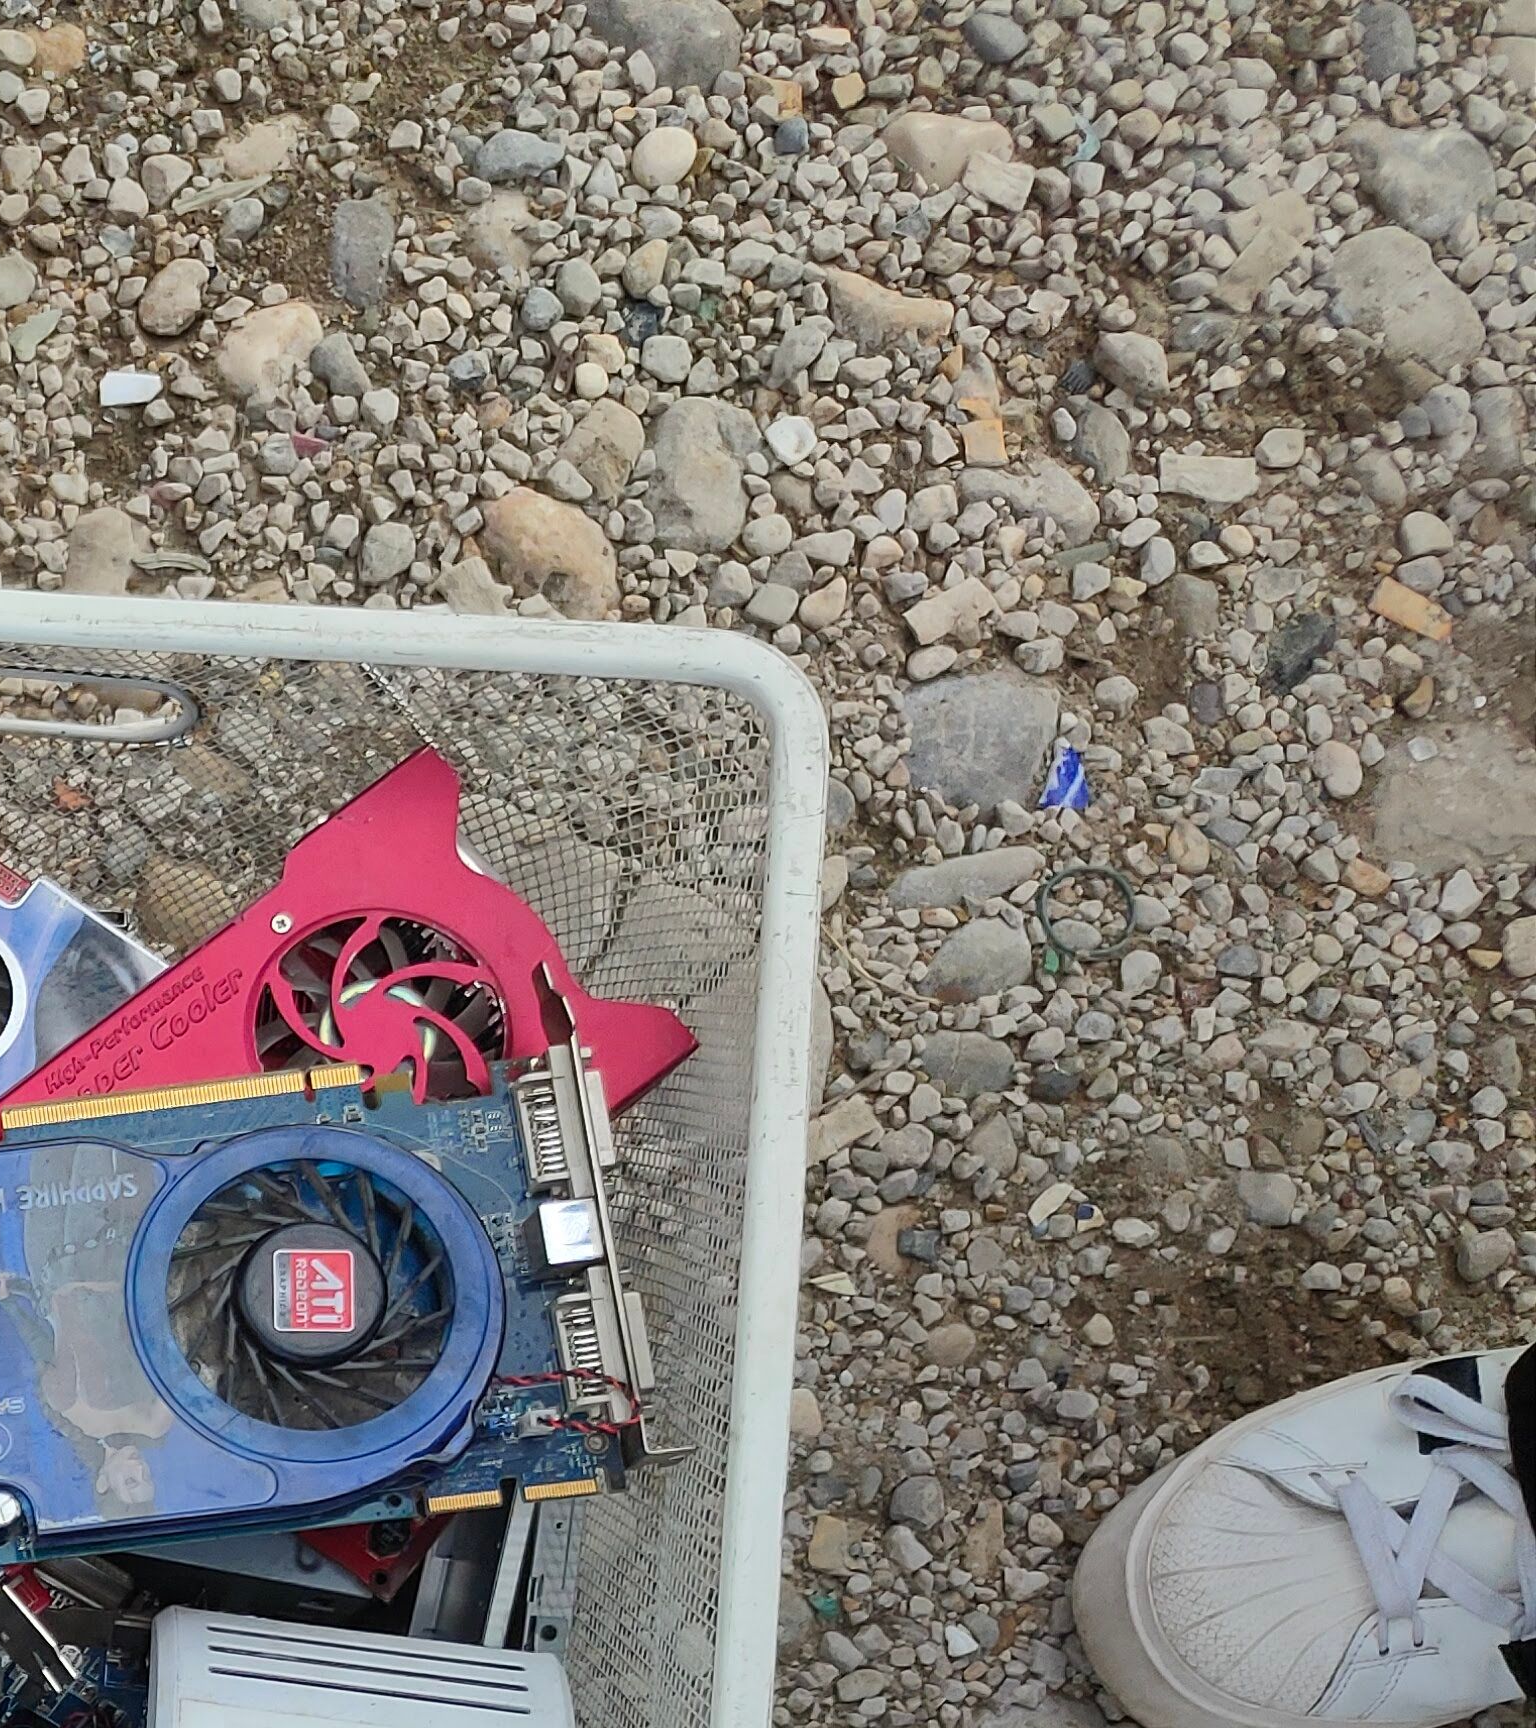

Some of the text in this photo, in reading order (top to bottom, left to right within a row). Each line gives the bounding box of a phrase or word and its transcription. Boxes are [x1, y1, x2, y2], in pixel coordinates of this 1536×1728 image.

[40, 963, 207, 1096] High-Performance
[144, 963, 251, 1054] Cooler
[14, 1171, 137, 1209] SAPPHIRE
[277, 1262, 286, 1319] GRAPHICS
[309, 1258, 344, 1323] ATI
